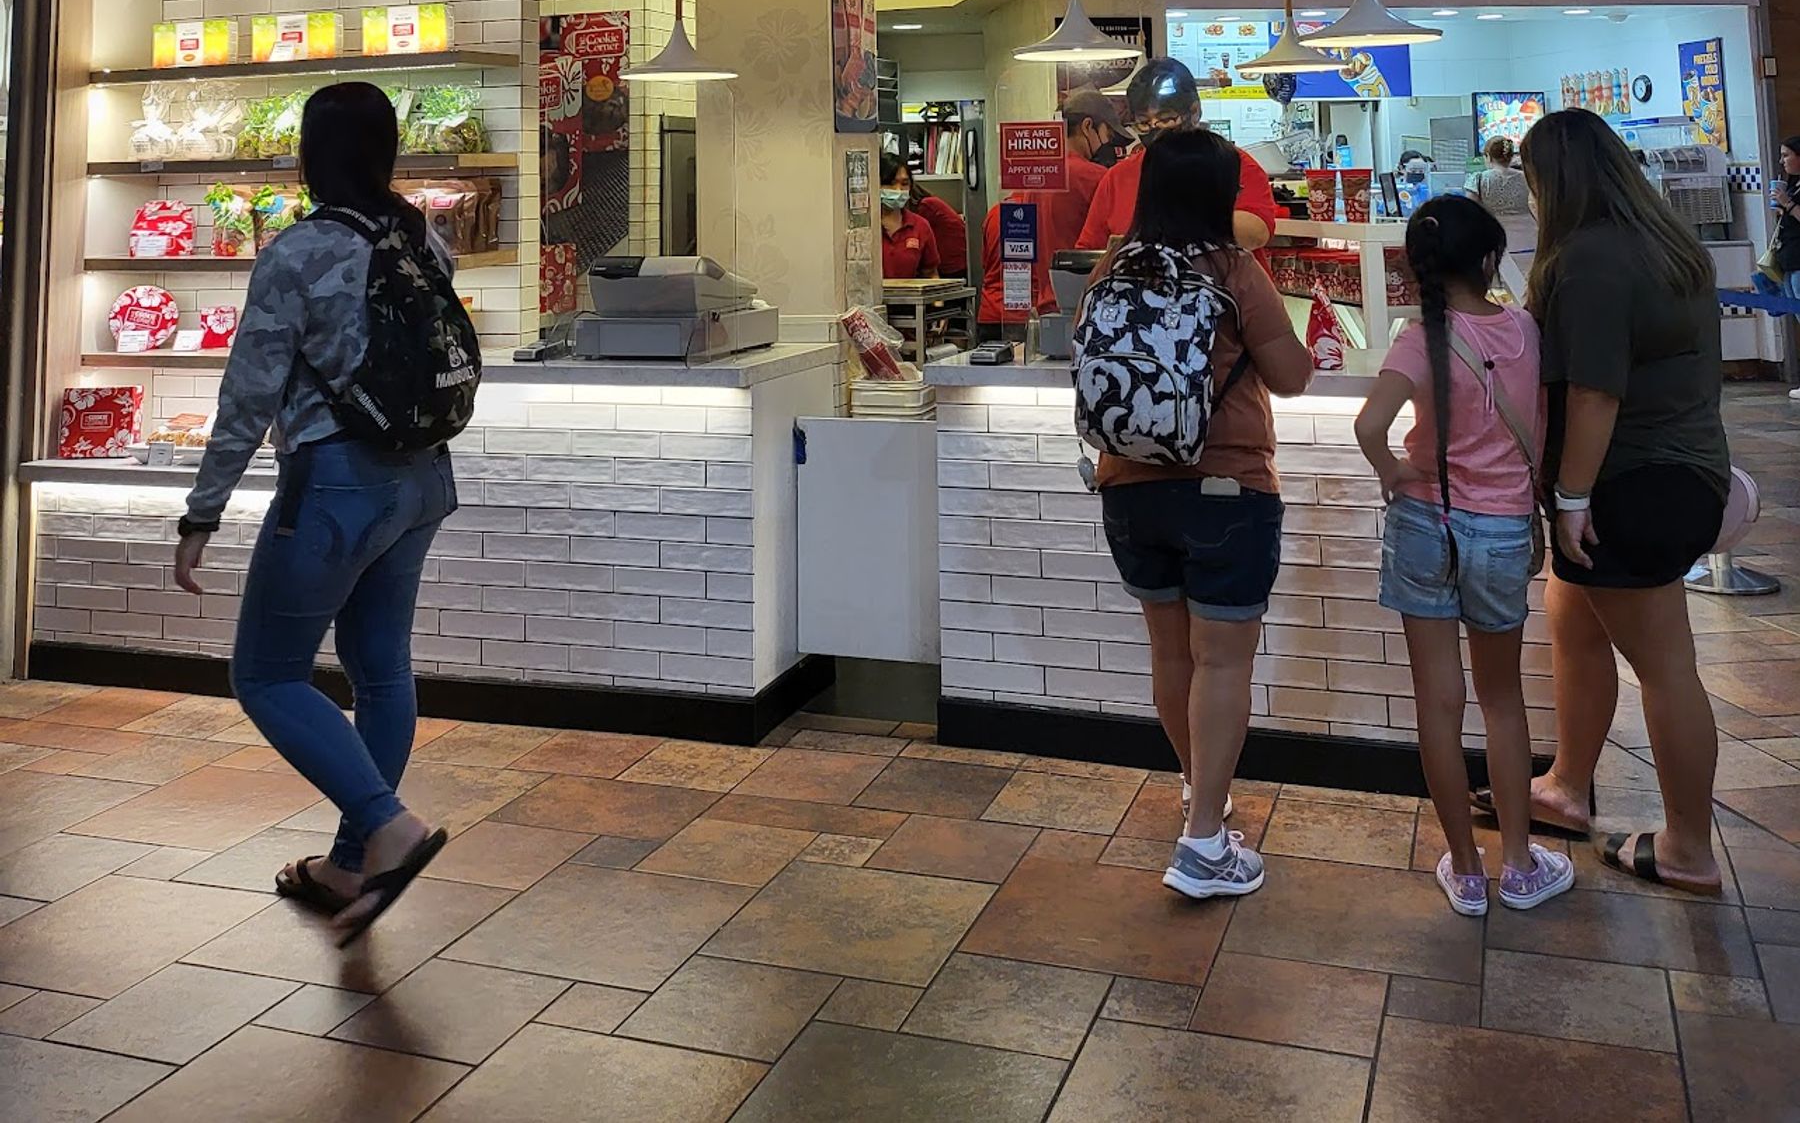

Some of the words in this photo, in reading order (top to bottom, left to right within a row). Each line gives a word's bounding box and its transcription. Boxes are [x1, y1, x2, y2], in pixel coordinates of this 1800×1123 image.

[586, 32, 619, 45] Cookie
[586, 42, 619, 53] Corner
[1014, 129, 1030, 138] WE
[1032, 129, 1051, 137] ARE
[1007, 138, 1059, 150] HIRING
[1008, 165, 1032, 174] APPLY
[1033, 165, 1059, 174] INSIDE
[1009, 244, 1030, 253] VISA
